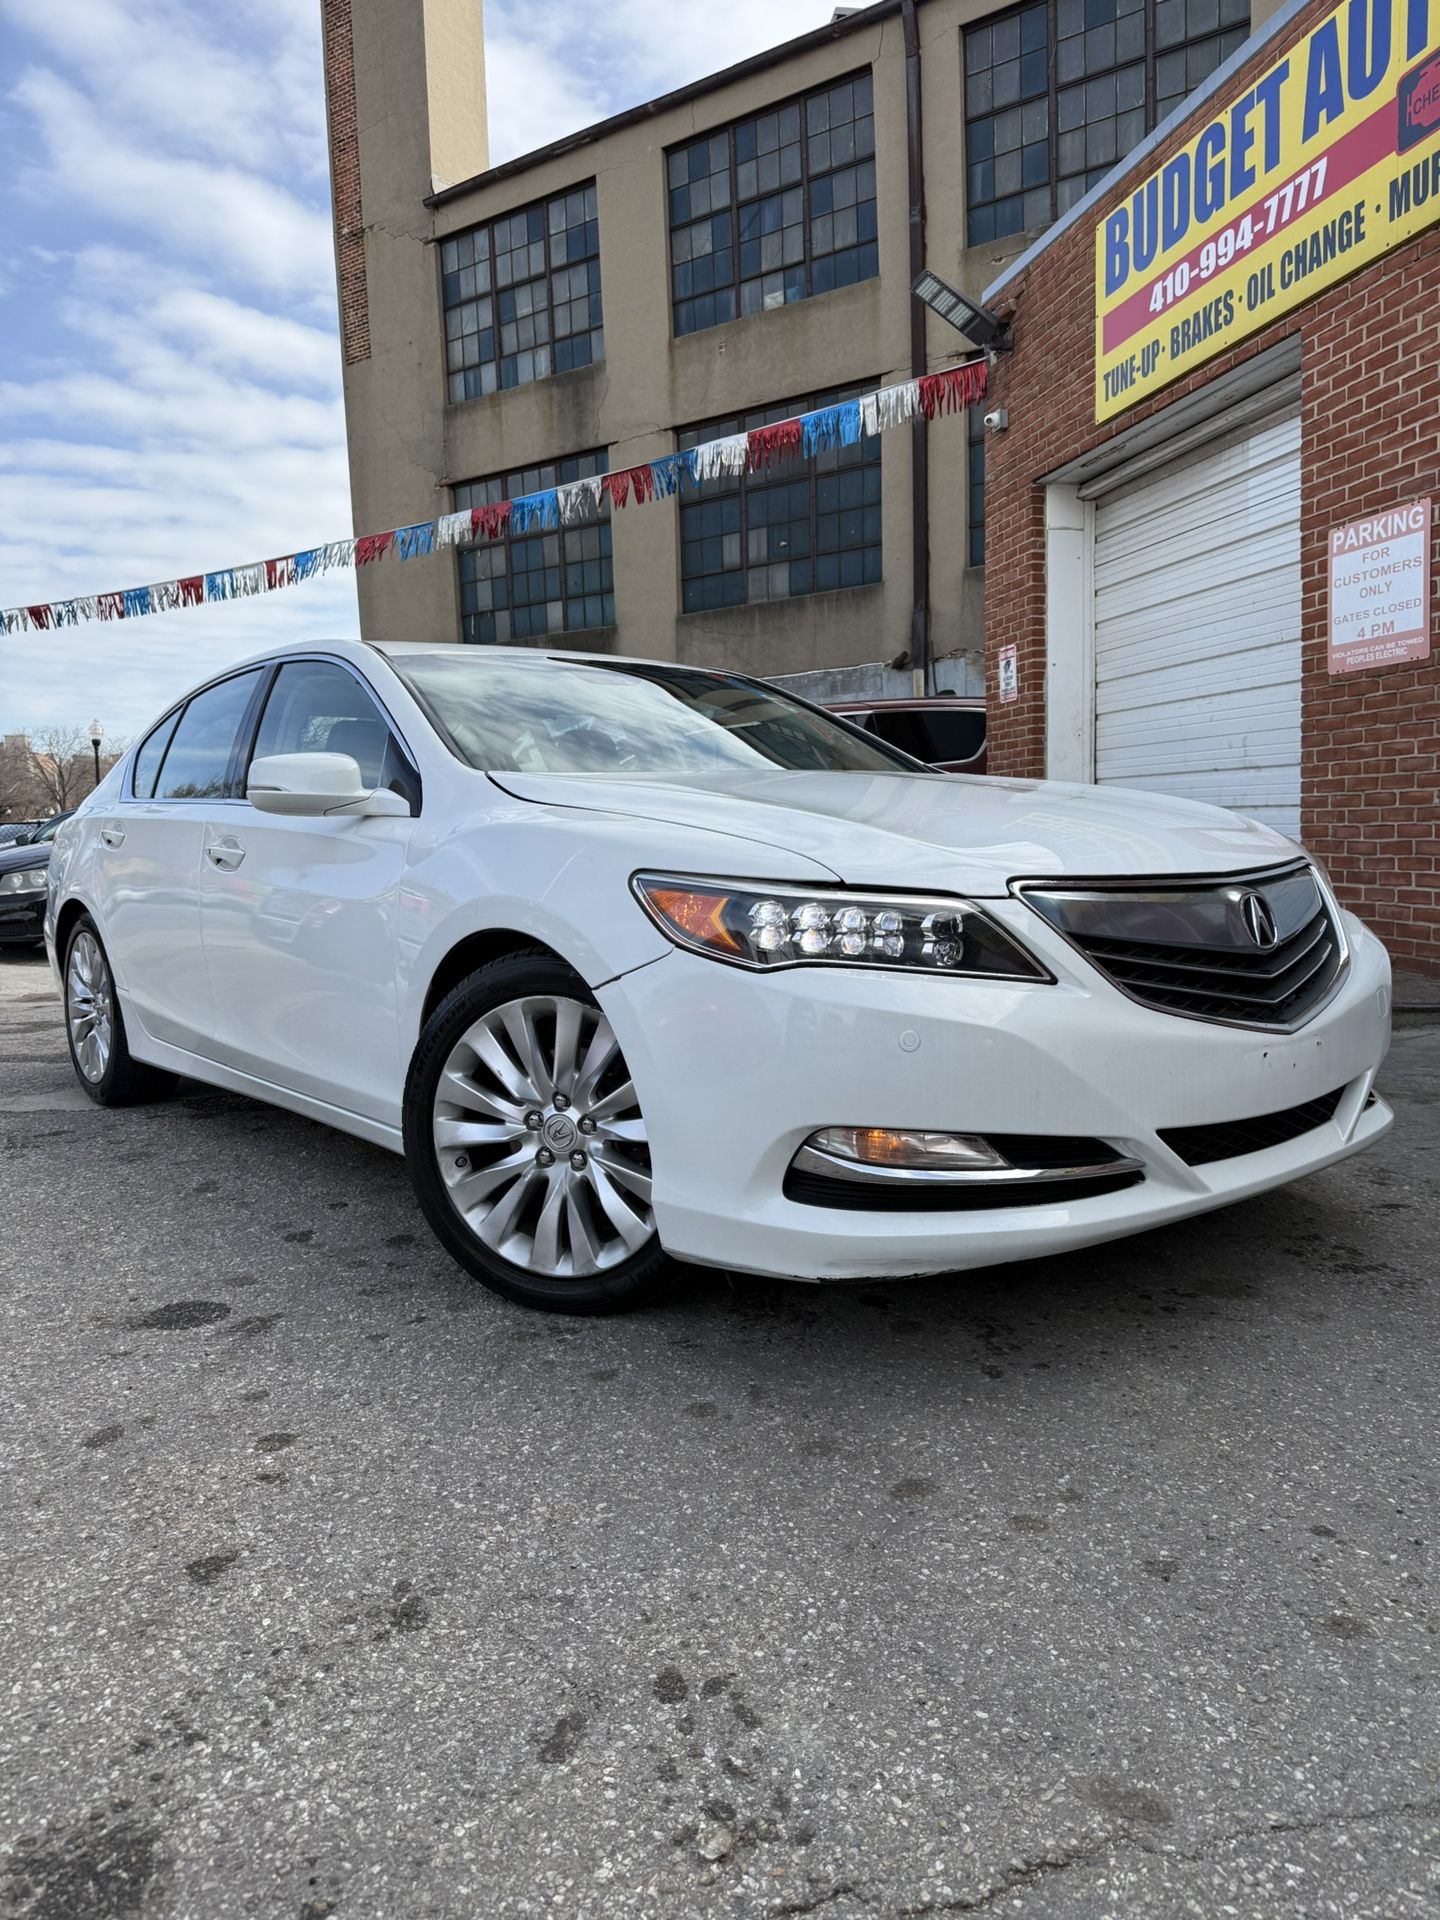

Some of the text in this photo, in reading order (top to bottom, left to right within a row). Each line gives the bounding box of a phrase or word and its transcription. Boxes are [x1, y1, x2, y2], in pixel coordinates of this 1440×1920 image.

[1104, 58, 1290, 298] BUDGET
[1148, 156, 1328, 313] 410-994-7777
[1103, 338, 1160, 402] TUNE-UP
[1170, 289, 1234, 361] BRAKES
[1246, 262, 1275, 312] OIL
[1280, 200, 1366, 290] CHANGE
[1333, 506, 1424, 553] PARKING
[1362, 547, 1390, 564] FOR
[1333, 556, 1422, 589] CUSTOMERS
[1360, 581, 1392, 599] ONLY
[1333, 597, 1422, 626] GATES CLOSED
[1357, 620, 1395, 639] 4 PM
[1332, 636, 1424, 659] VIOLATORS CAN BE TOWED
[1376, 647, 1408, 660] ELECTRIC
